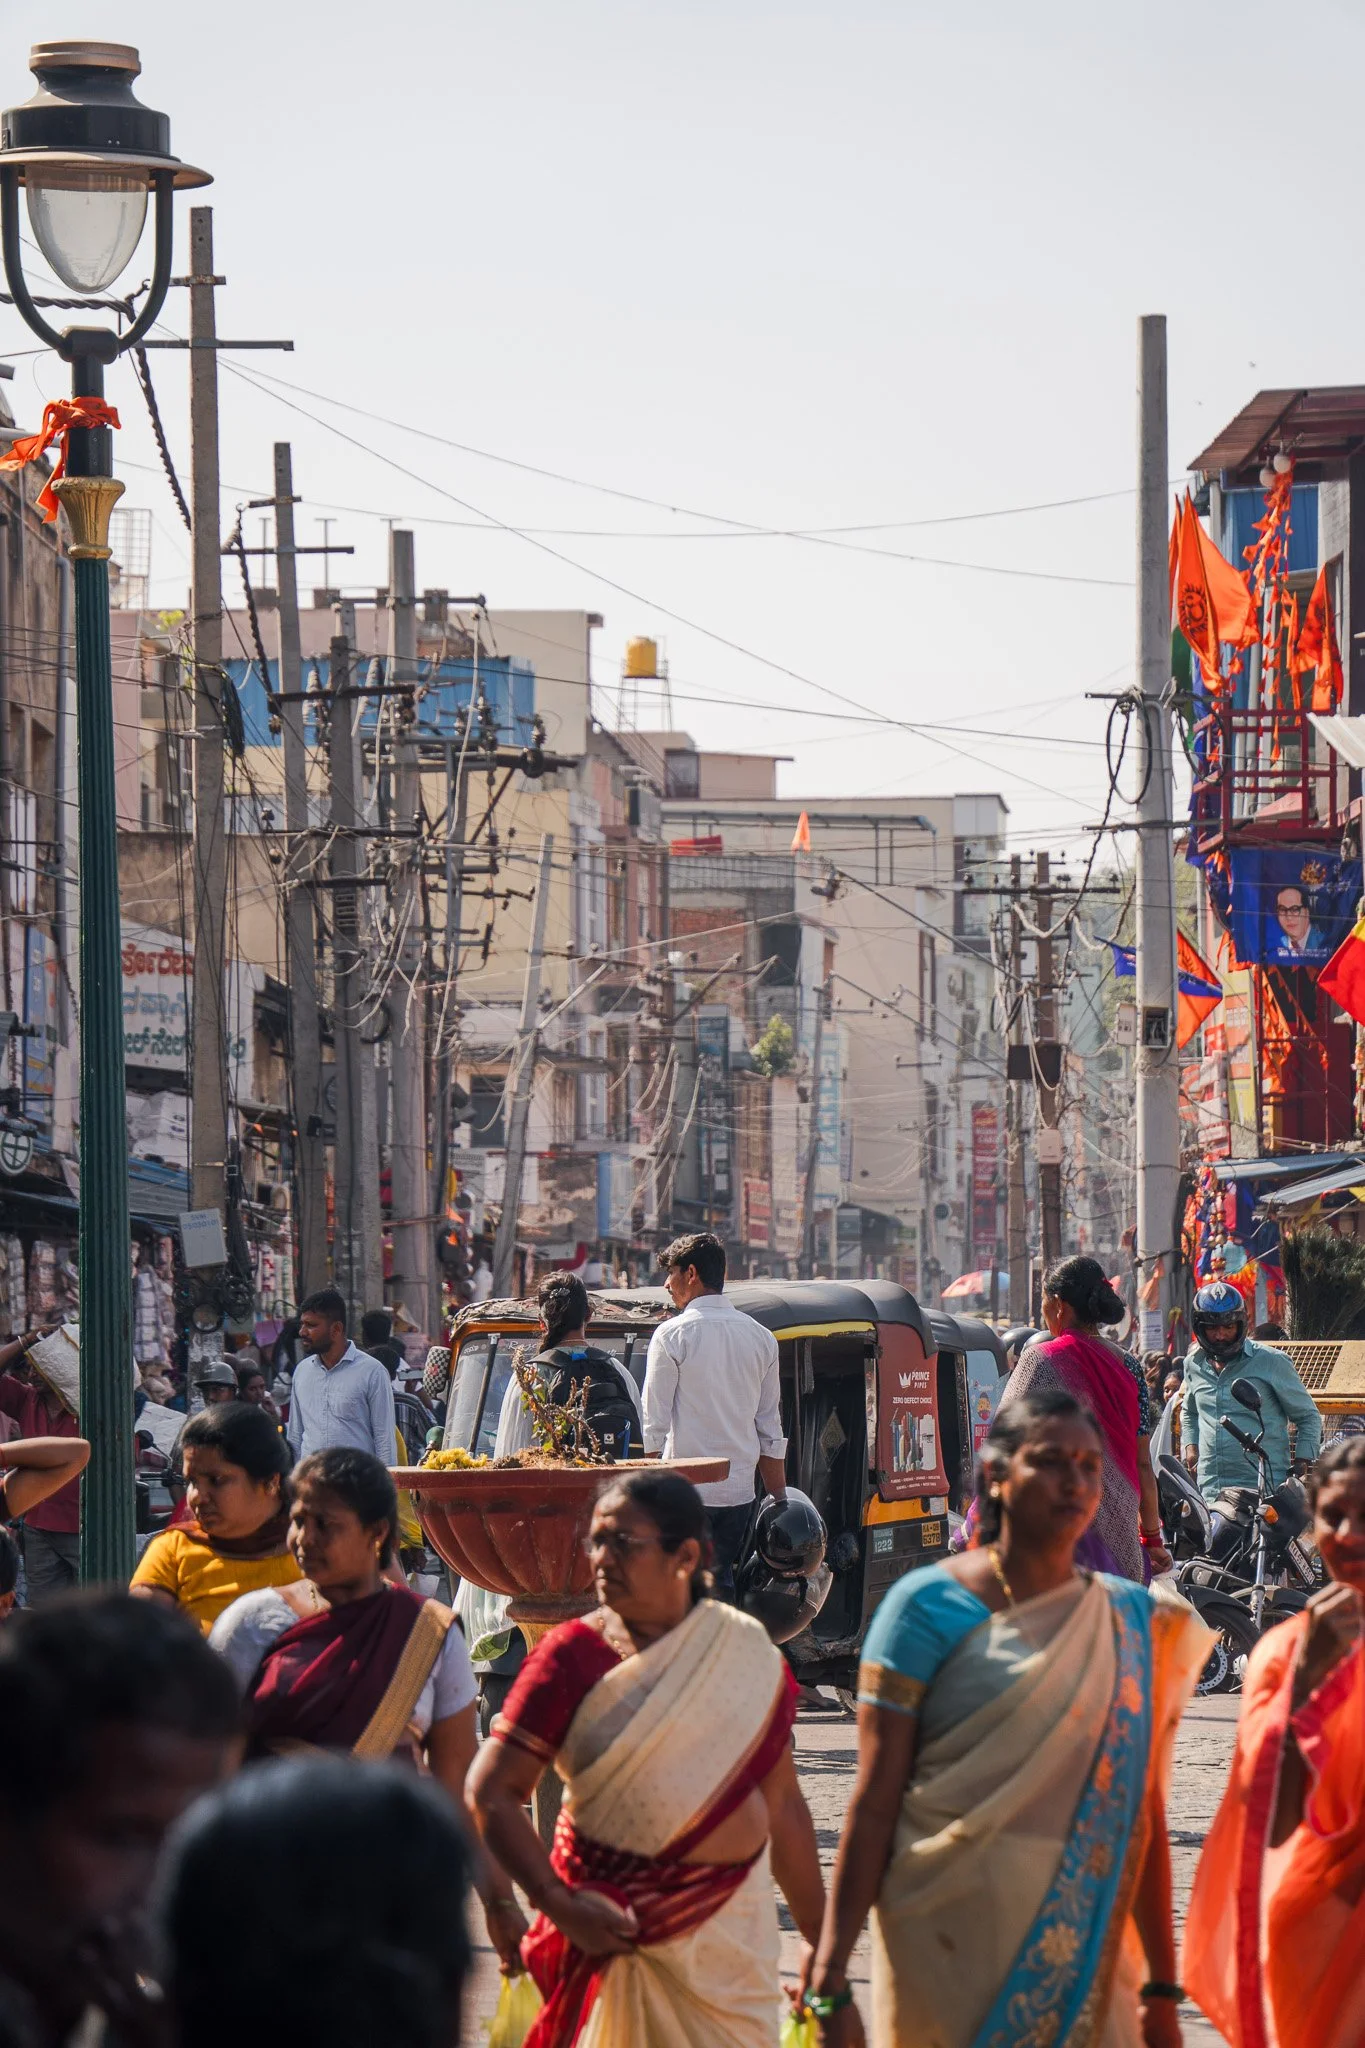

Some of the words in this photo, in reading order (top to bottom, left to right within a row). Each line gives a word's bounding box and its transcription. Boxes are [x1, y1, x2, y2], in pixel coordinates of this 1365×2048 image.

[912, 1371, 930, 1381] PRINCE
[914, 1381, 927, 1389] PIPES
[919, 1396, 932, 1404] CHOICE
[874, 1539, 893, 1553] 1222
